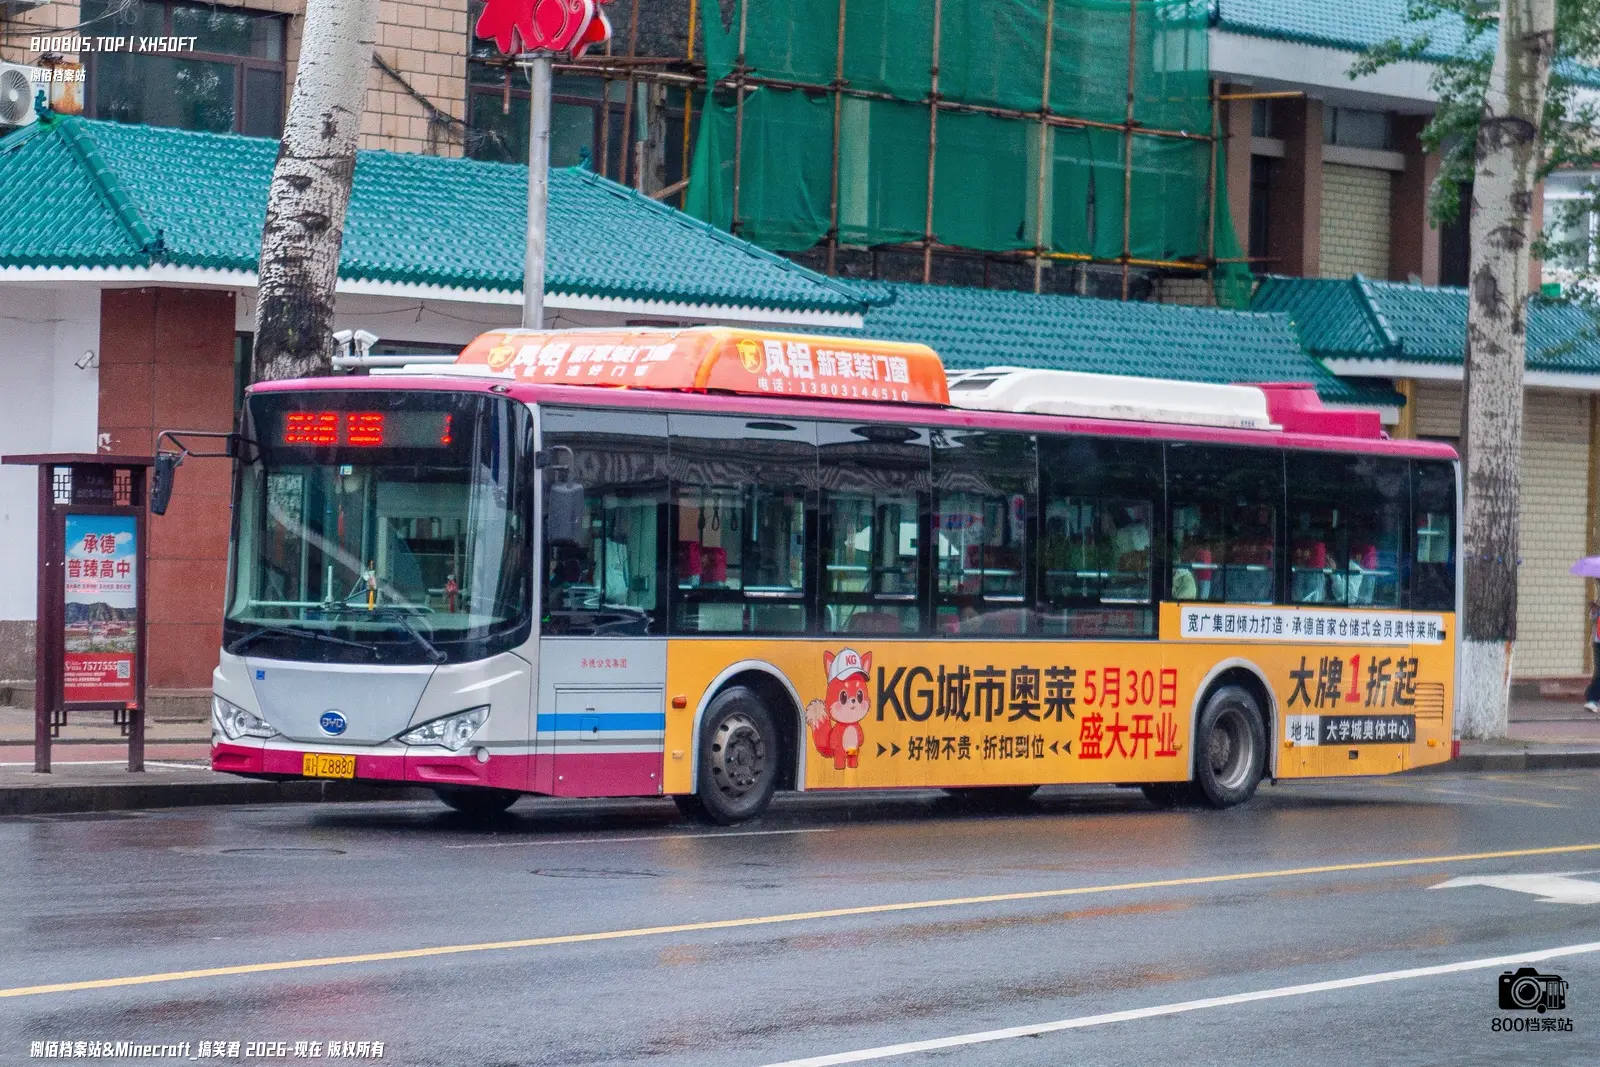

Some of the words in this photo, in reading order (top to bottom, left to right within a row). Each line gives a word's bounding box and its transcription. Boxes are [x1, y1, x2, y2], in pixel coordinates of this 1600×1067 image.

[816, 350, 909, 384] 新家装门窗
[83, 534, 116, 554] 承德
[68, 560, 130, 579] 普臻高中
[845, 655, 857, 666] KG
[876, 664, 1076, 723] KG城市奥莱
[1083, 667, 1177, 710] 5月30日
[1287, 654, 1419, 708] 大牌1折起
[322, 717, 344, 728] BYD
[1078, 711, 1177, 760] 盛大开业
[1290, 723, 1316, 741] 地址
[1326, 721, 1411, 741] 大学城奥体中心
